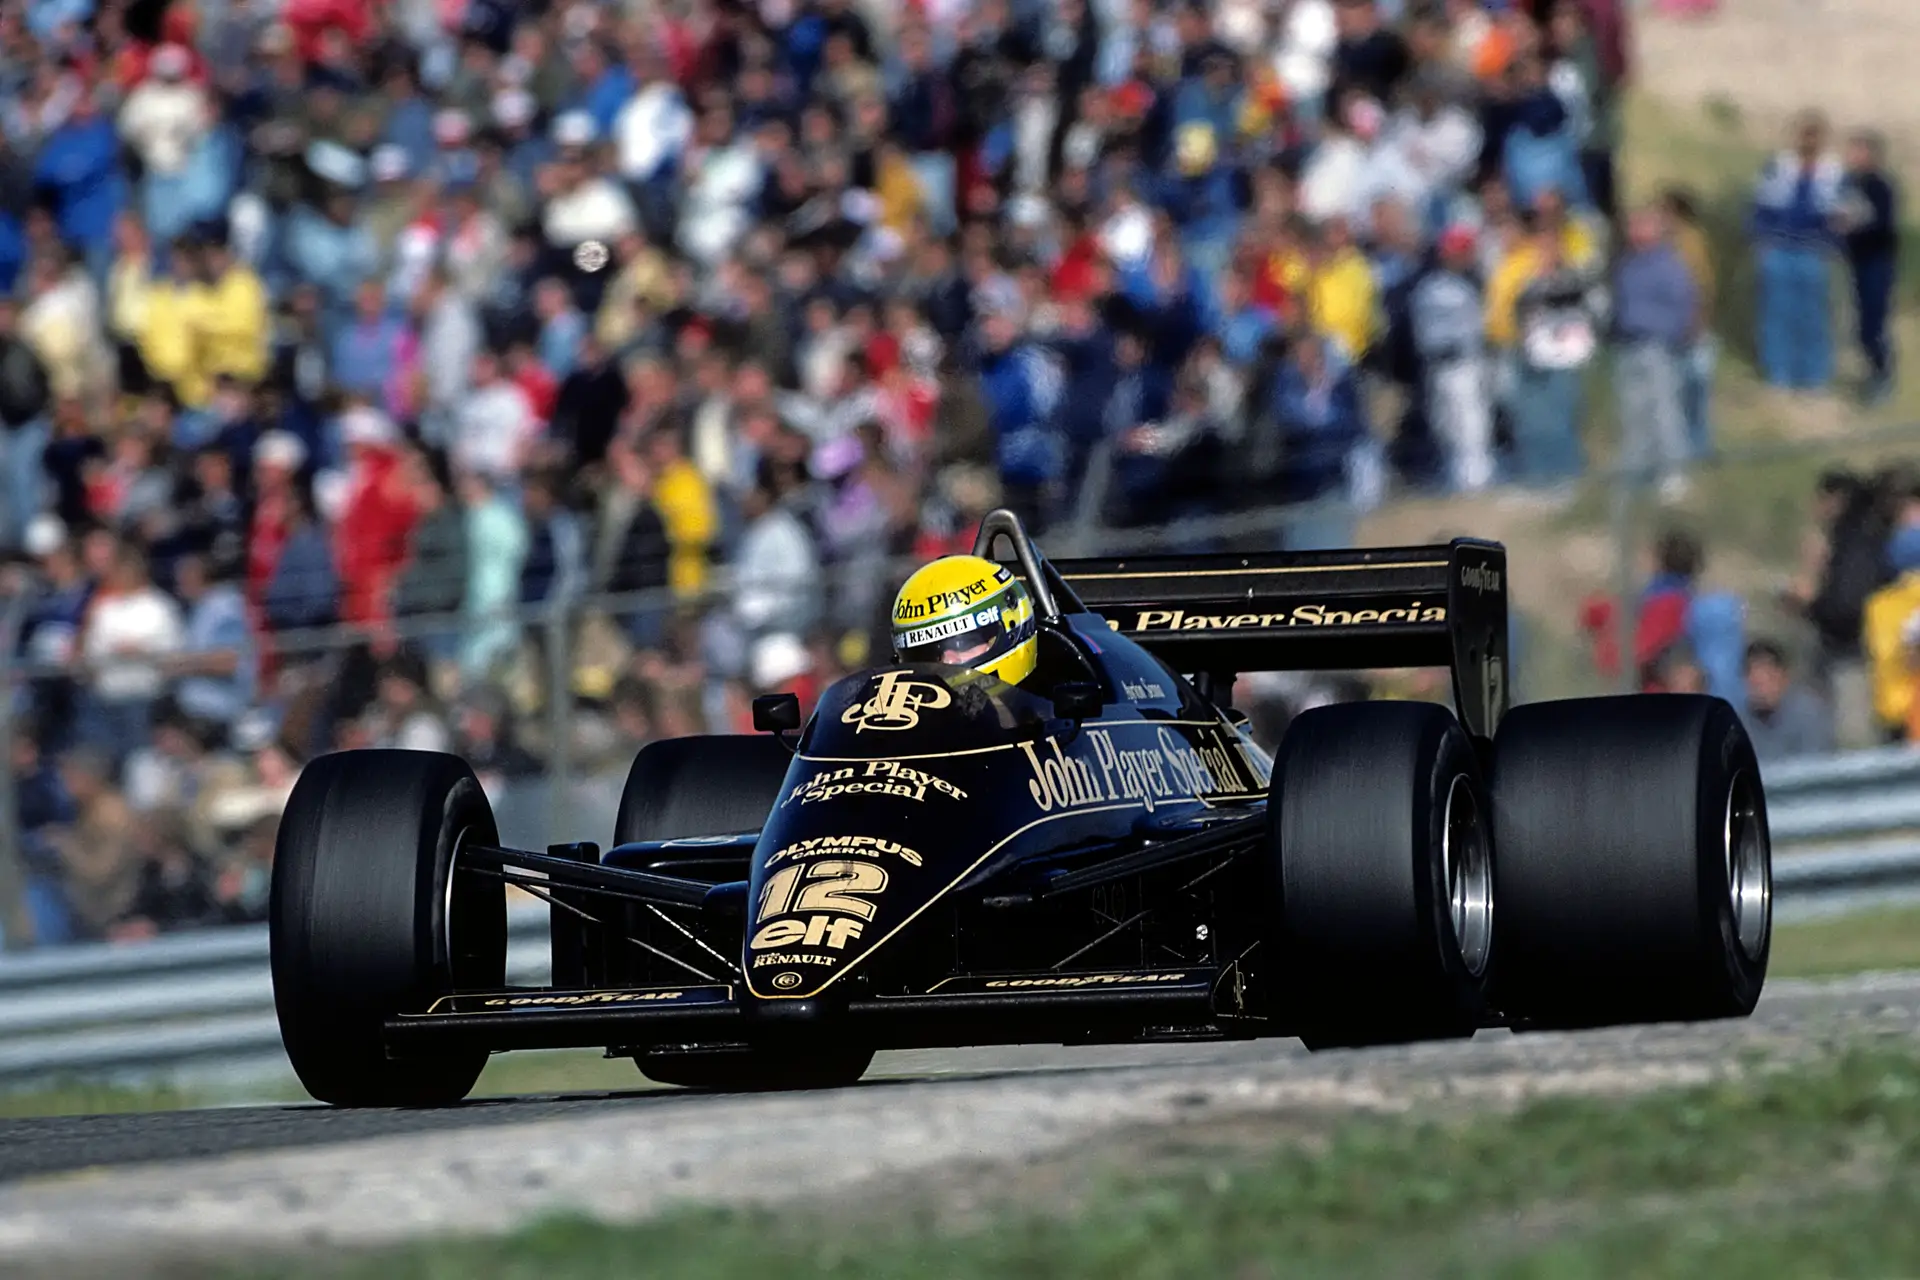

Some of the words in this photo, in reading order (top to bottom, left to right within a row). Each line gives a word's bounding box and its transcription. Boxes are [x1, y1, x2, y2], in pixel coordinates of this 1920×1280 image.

[926, 578, 988, 615] Player
[909, 617, 968, 644] RENAULT
[975, 605, 1000, 626] elf
[861, 760, 969, 801] Player
[1018, 736, 1104, 812] John
[1087, 730, 1173, 813] Player
[1157, 726, 1248, 809] Special
[801, 778, 926, 806] Special
[764, 836, 924, 868] OLYMPUS
[792, 847, 880, 860] CAMERAS
[757, 859, 890, 924] 12
[750, 915, 865, 950] elf
[753, 953, 837, 968] RENAULT
[986, 973, 1185, 987] GOODYEAR
[485, 992, 682, 1005] GOODYEAR
